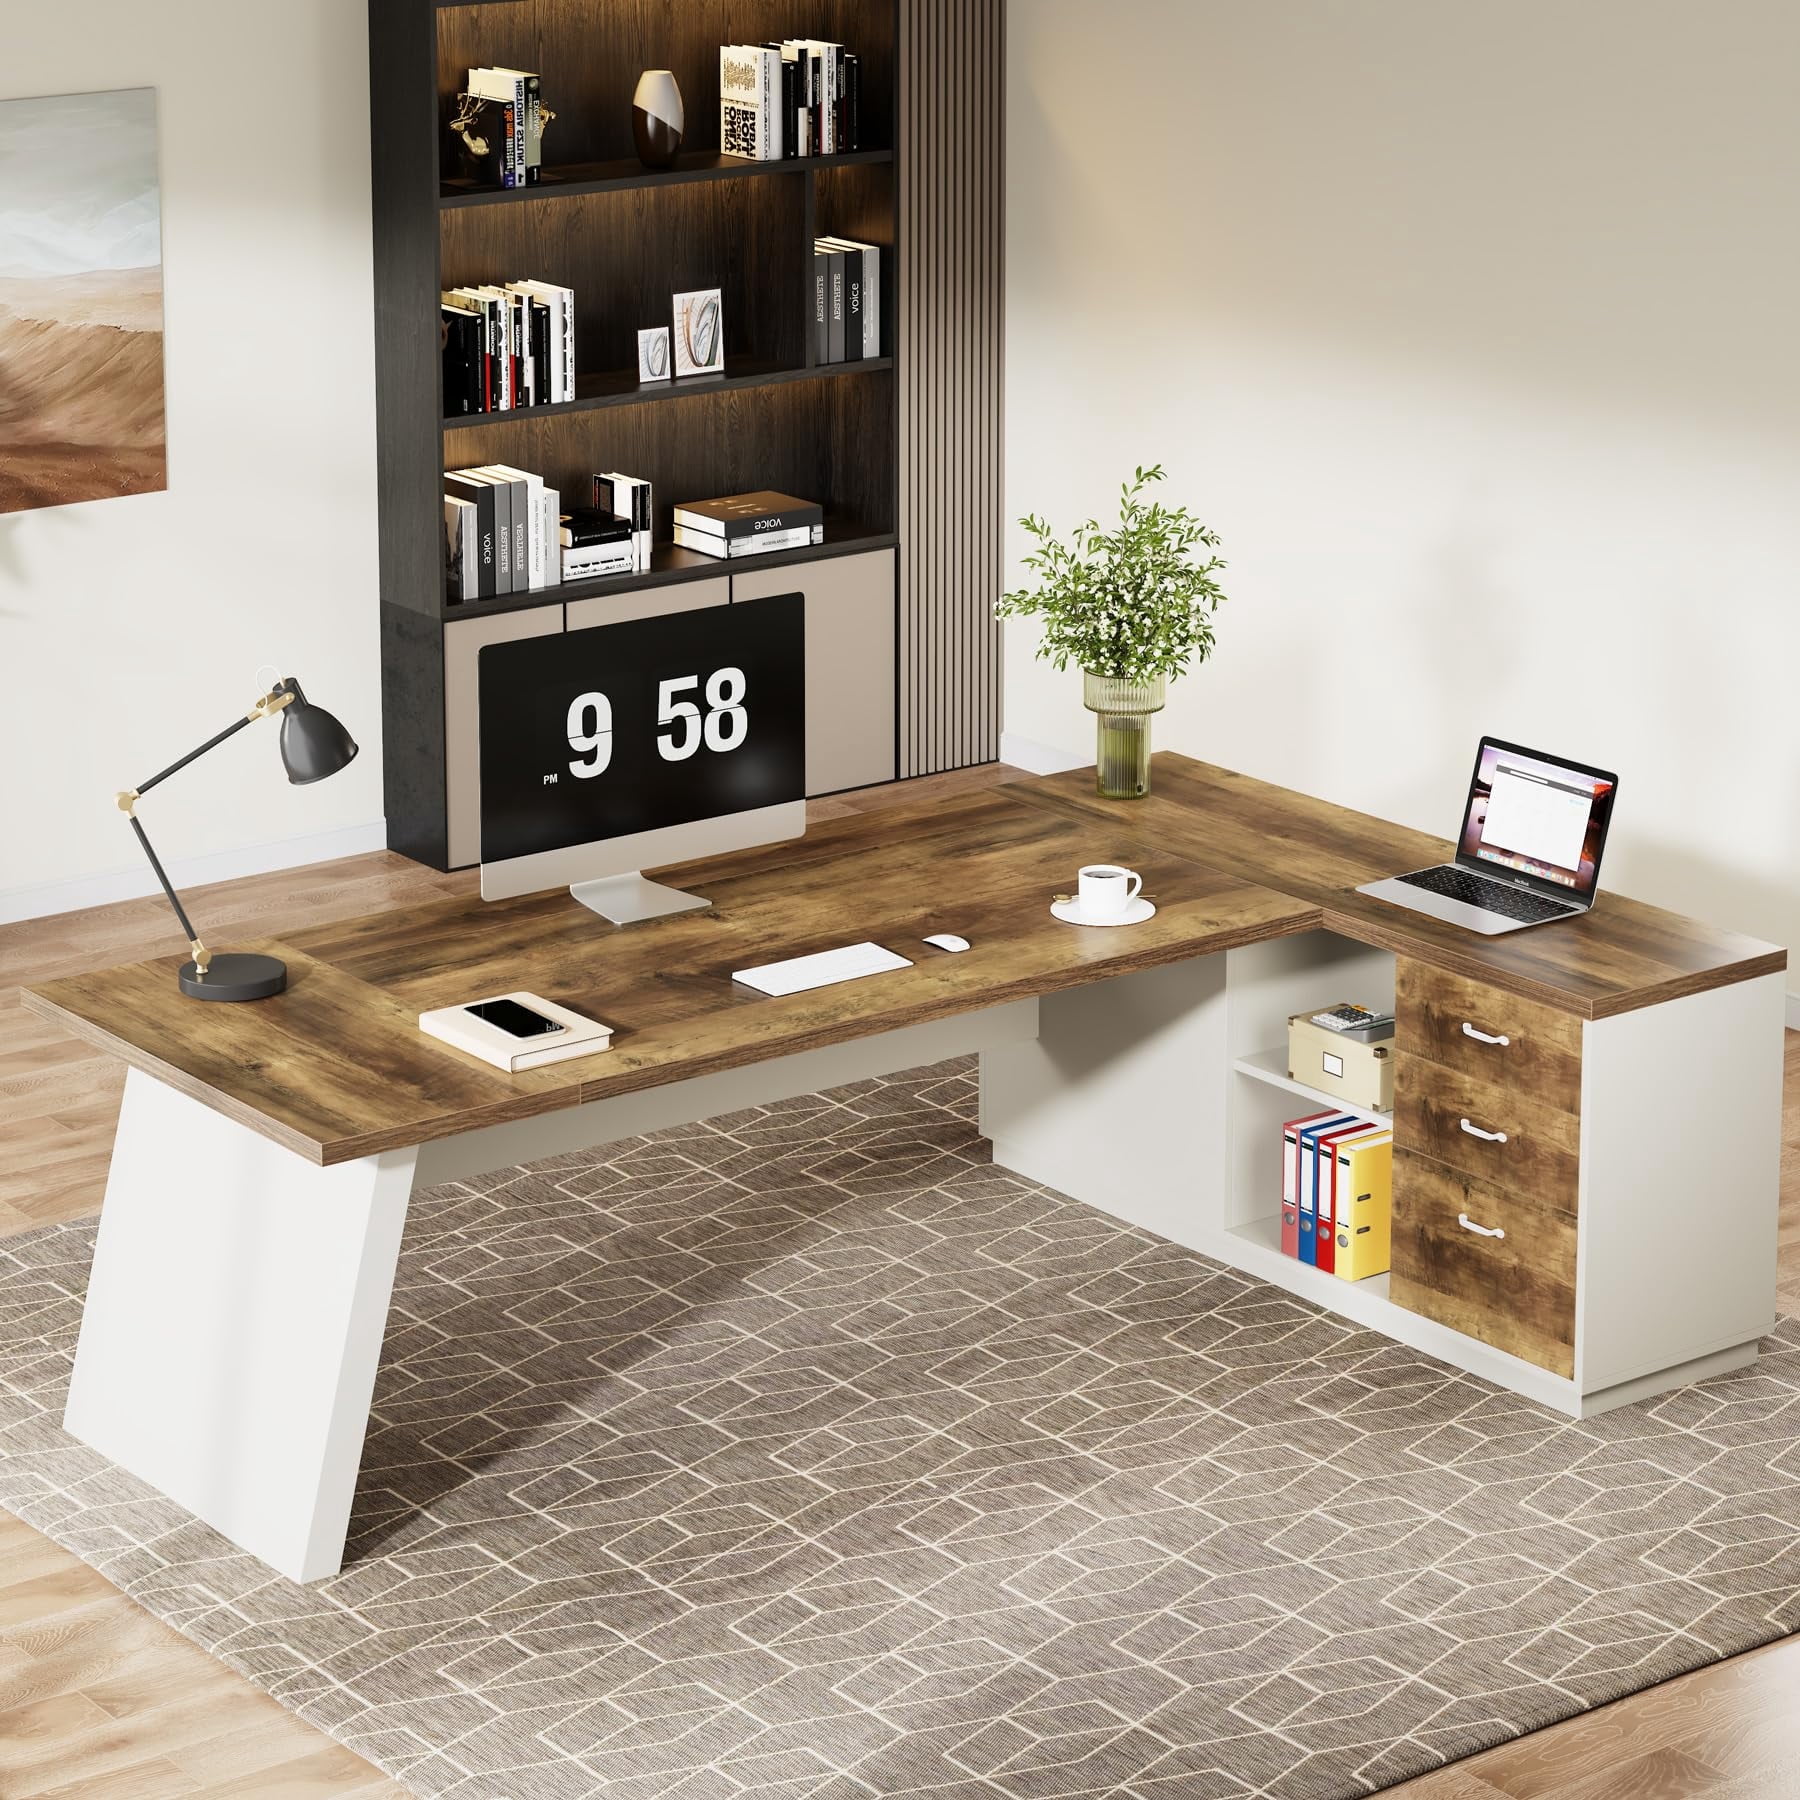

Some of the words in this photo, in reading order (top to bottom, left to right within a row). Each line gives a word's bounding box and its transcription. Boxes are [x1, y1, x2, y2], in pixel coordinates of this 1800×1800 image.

[850, 282, 859, 314] voice
[754, 518, 782, 530] voice
[483, 533, 493, 564] voice
[543, 773, 558, 785] PM
[566, 691, 613, 779] 9
[657, 667, 748, 762] 58
